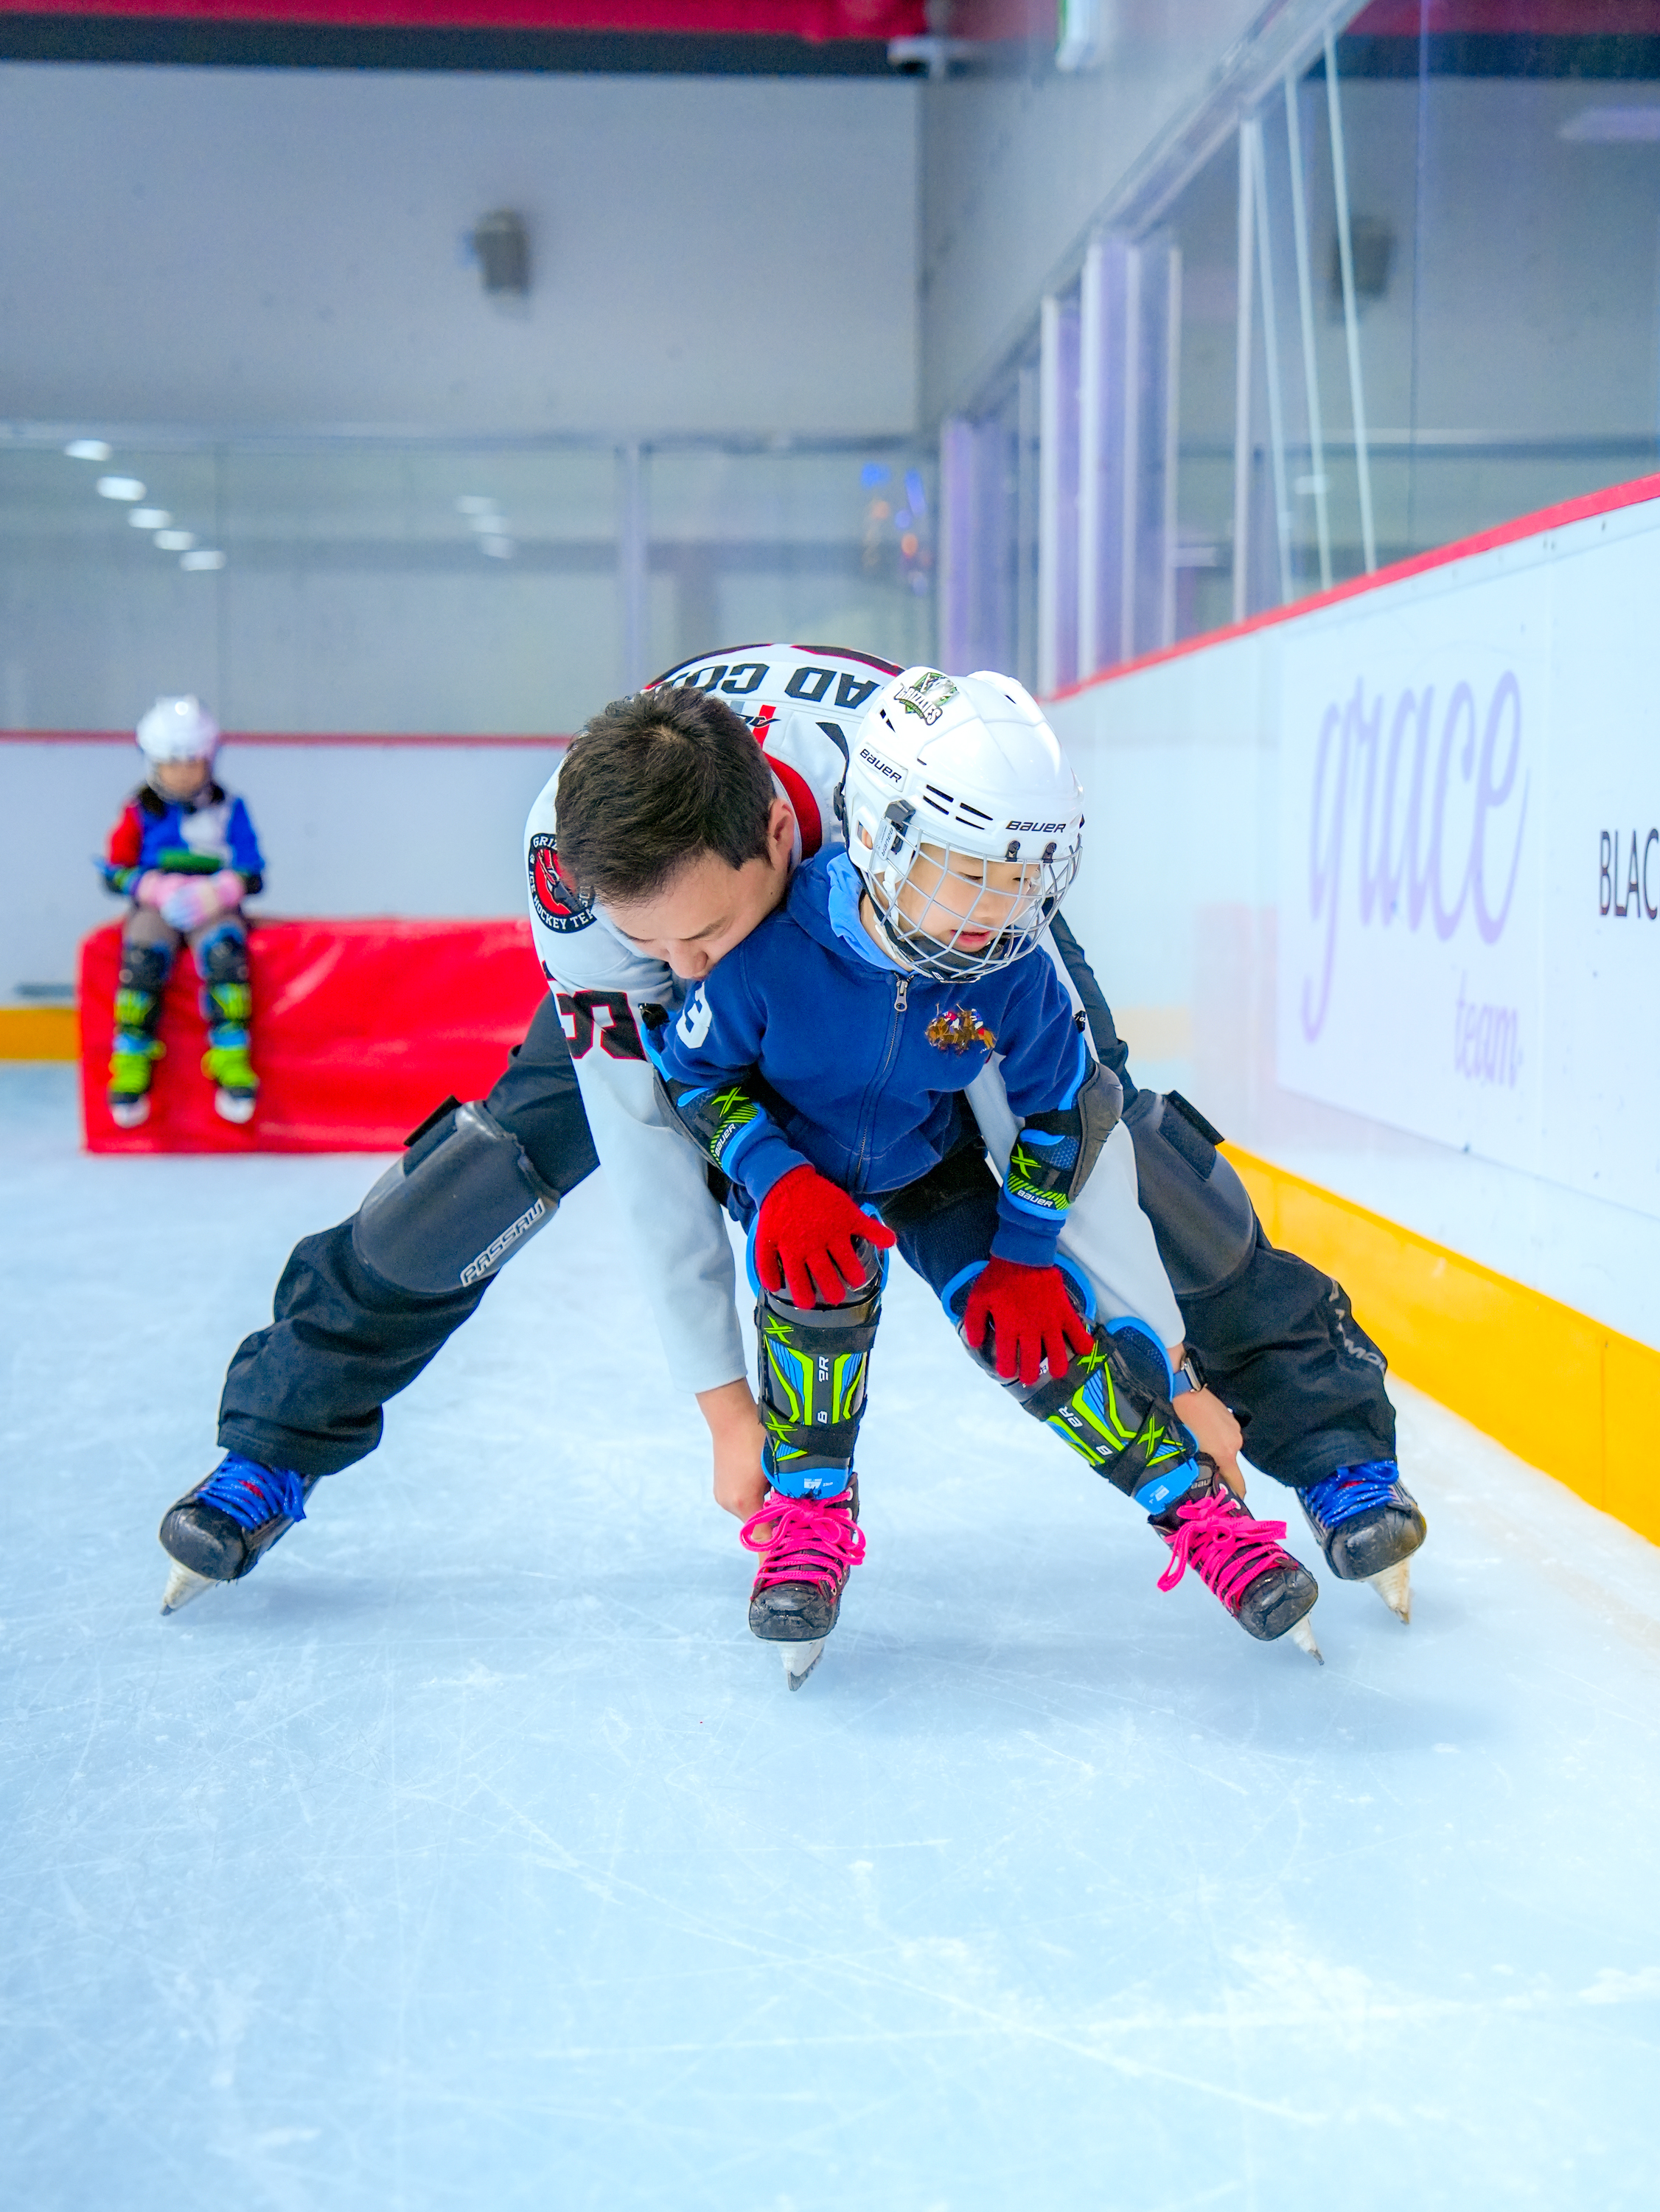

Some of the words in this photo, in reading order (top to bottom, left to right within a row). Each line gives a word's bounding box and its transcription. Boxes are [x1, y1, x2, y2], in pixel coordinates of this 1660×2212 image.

[658, 664, 770, 694] CO
[784, 667, 885, 709] AD
[1301, 669, 1531, 1043] grace
[1600, 828, 1660, 919] BLAC
[460, 1197, 545, 1287] PASSAU
